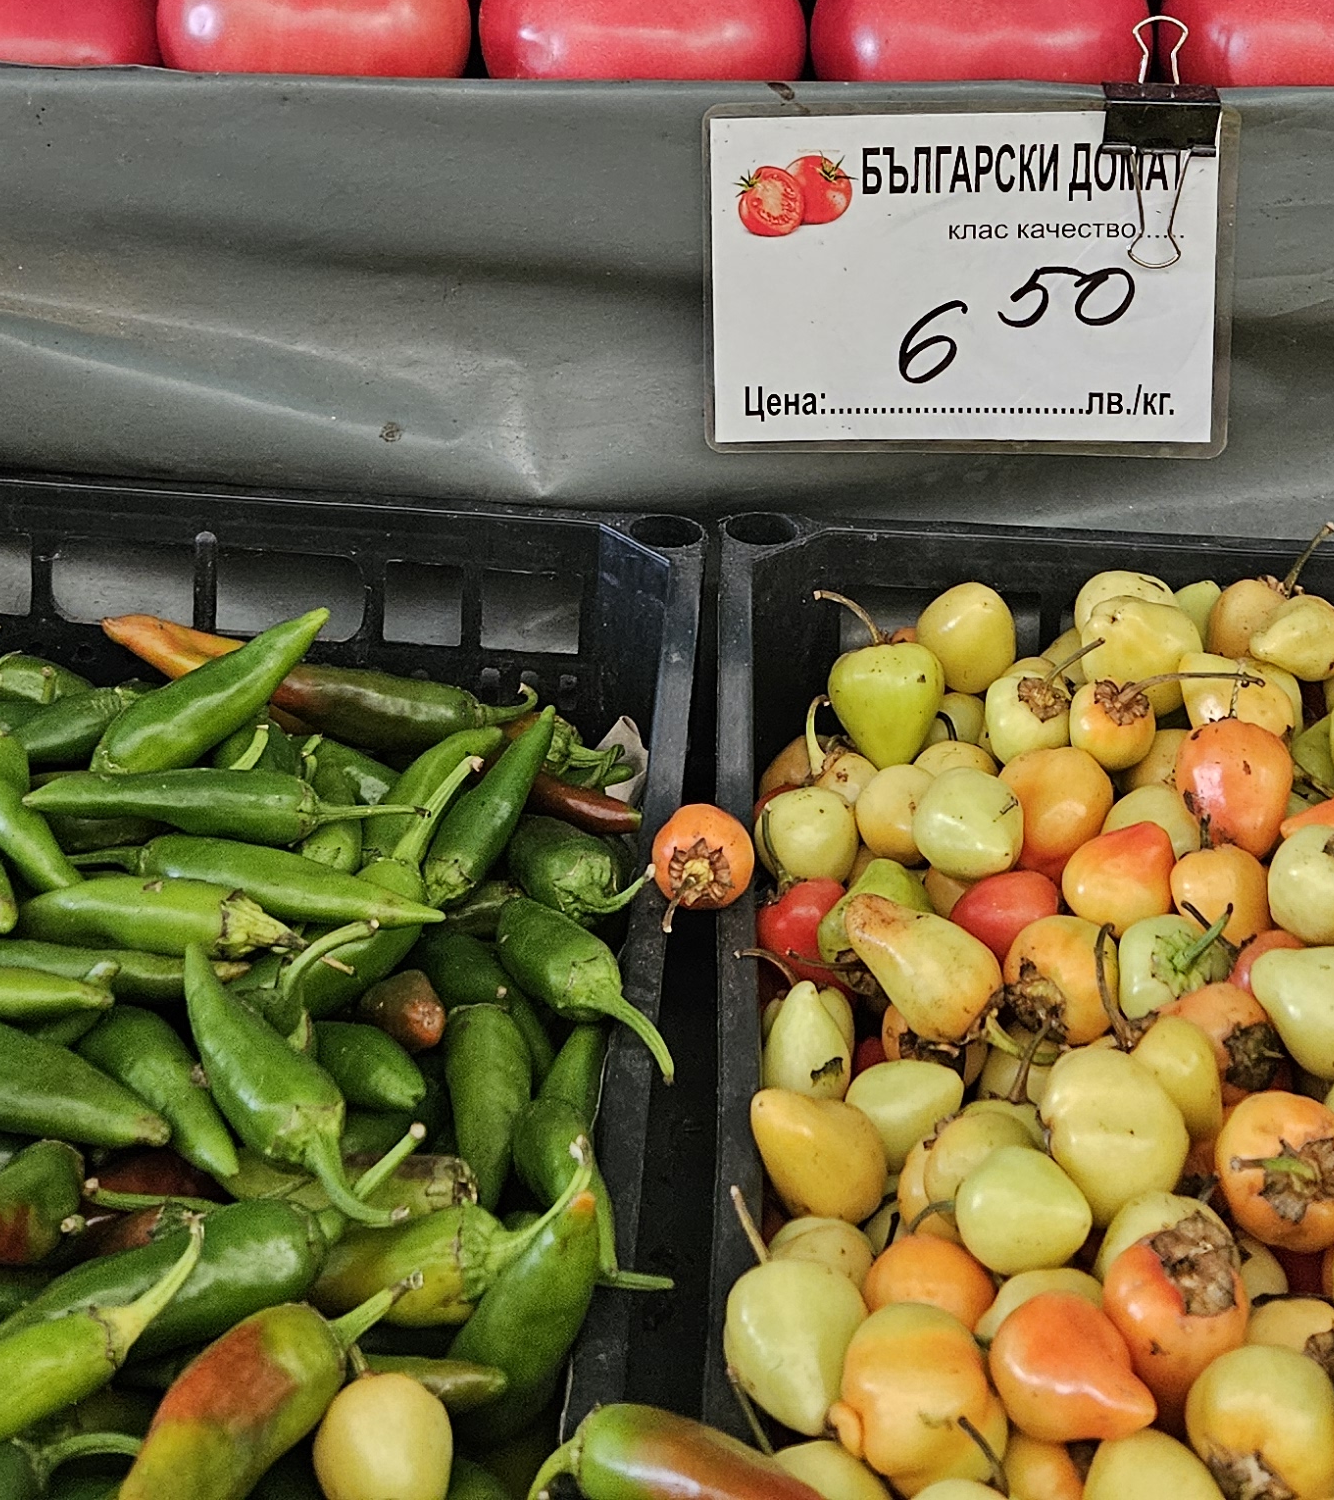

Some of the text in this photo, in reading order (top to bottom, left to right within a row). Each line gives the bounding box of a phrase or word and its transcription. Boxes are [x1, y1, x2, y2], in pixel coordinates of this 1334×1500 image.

[861, 143, 1059, 195] БЪЛГАРСКИ
[948, 221, 1137, 241] клас качество
[898, 265, 1136, 384] 6 50
[1085, 384, 1175, 416] лв./кг.
